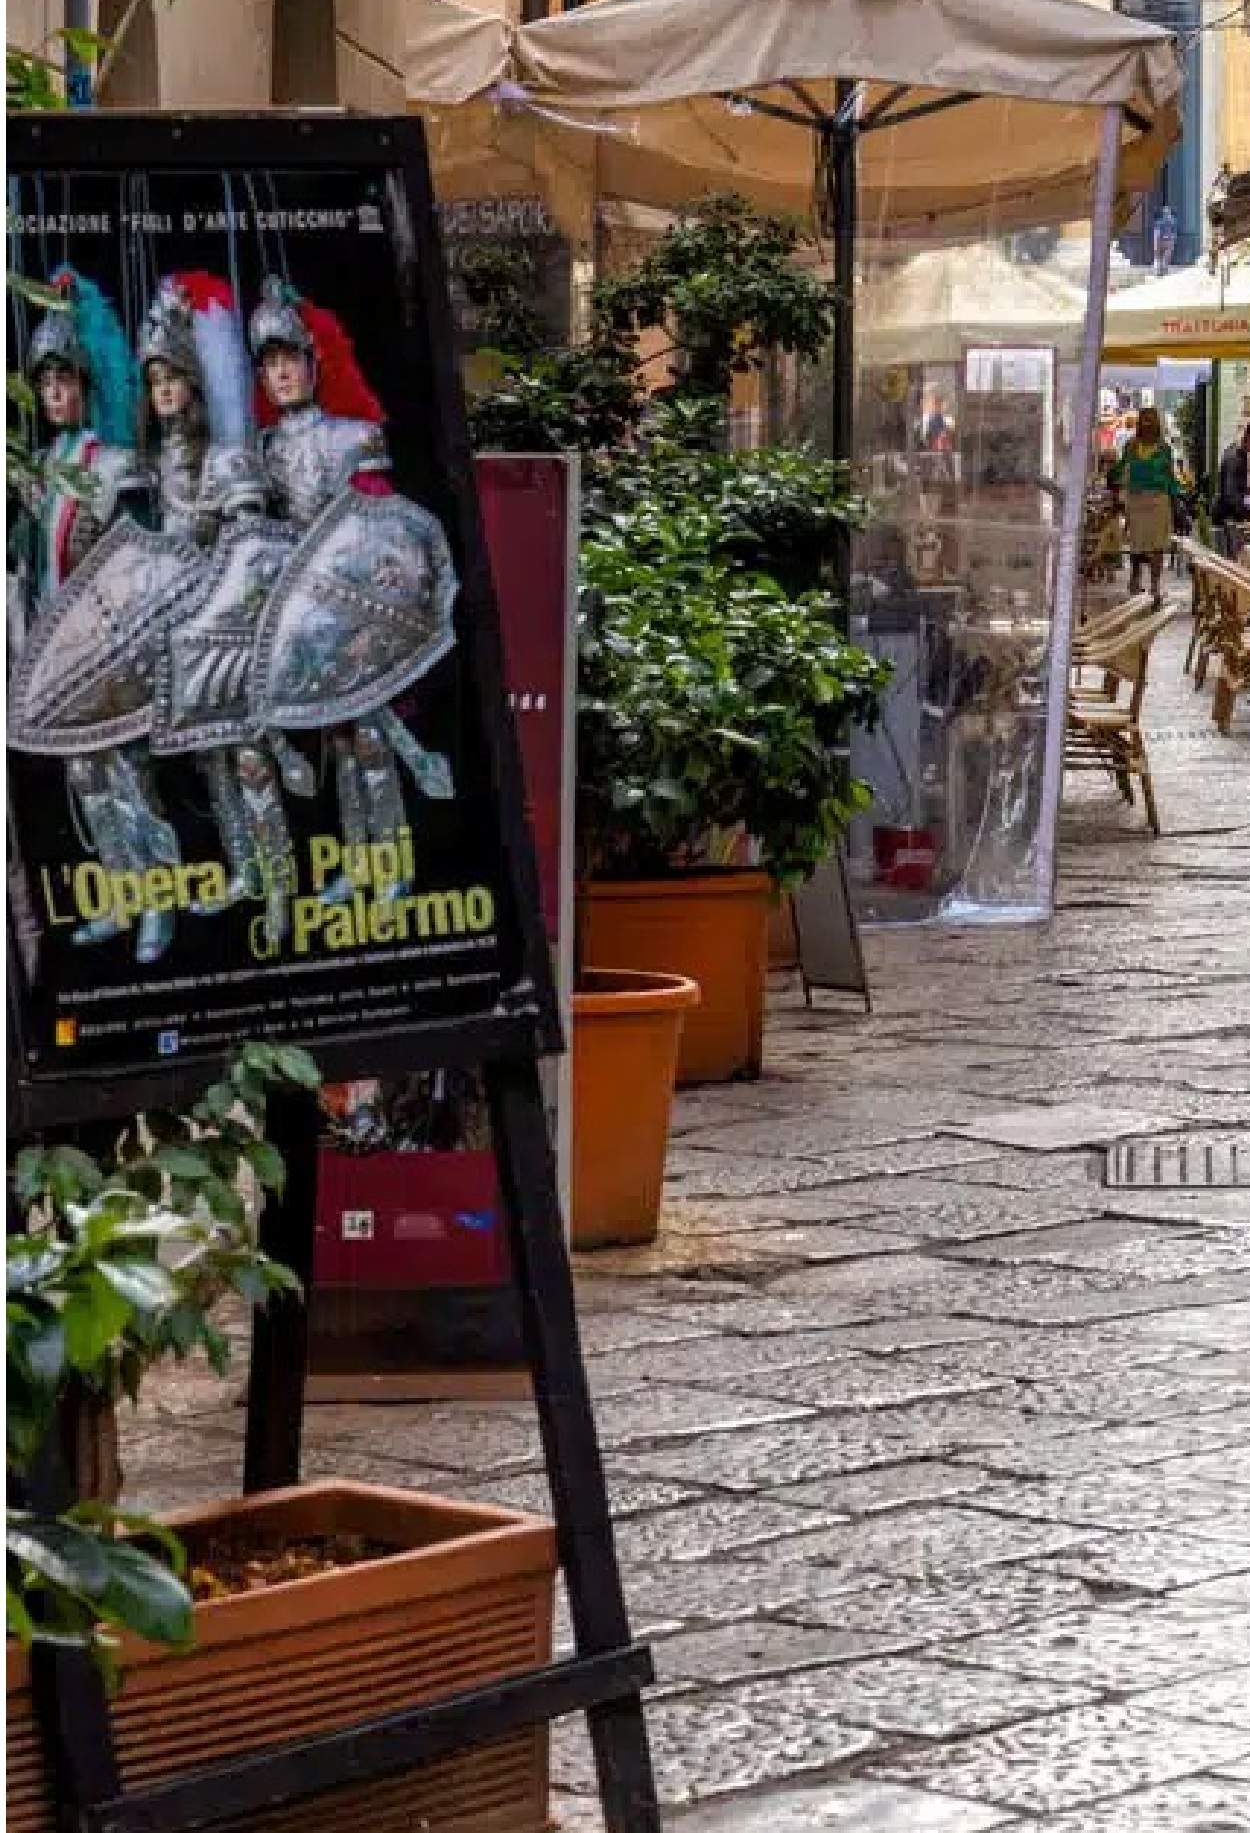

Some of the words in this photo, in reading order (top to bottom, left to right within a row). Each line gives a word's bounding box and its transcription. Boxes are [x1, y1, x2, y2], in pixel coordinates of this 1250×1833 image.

[42, 862, 227, 932] L'Opera
[310, 825, 415, 903] Pupi
[294, 886, 494, 953] Palermo
